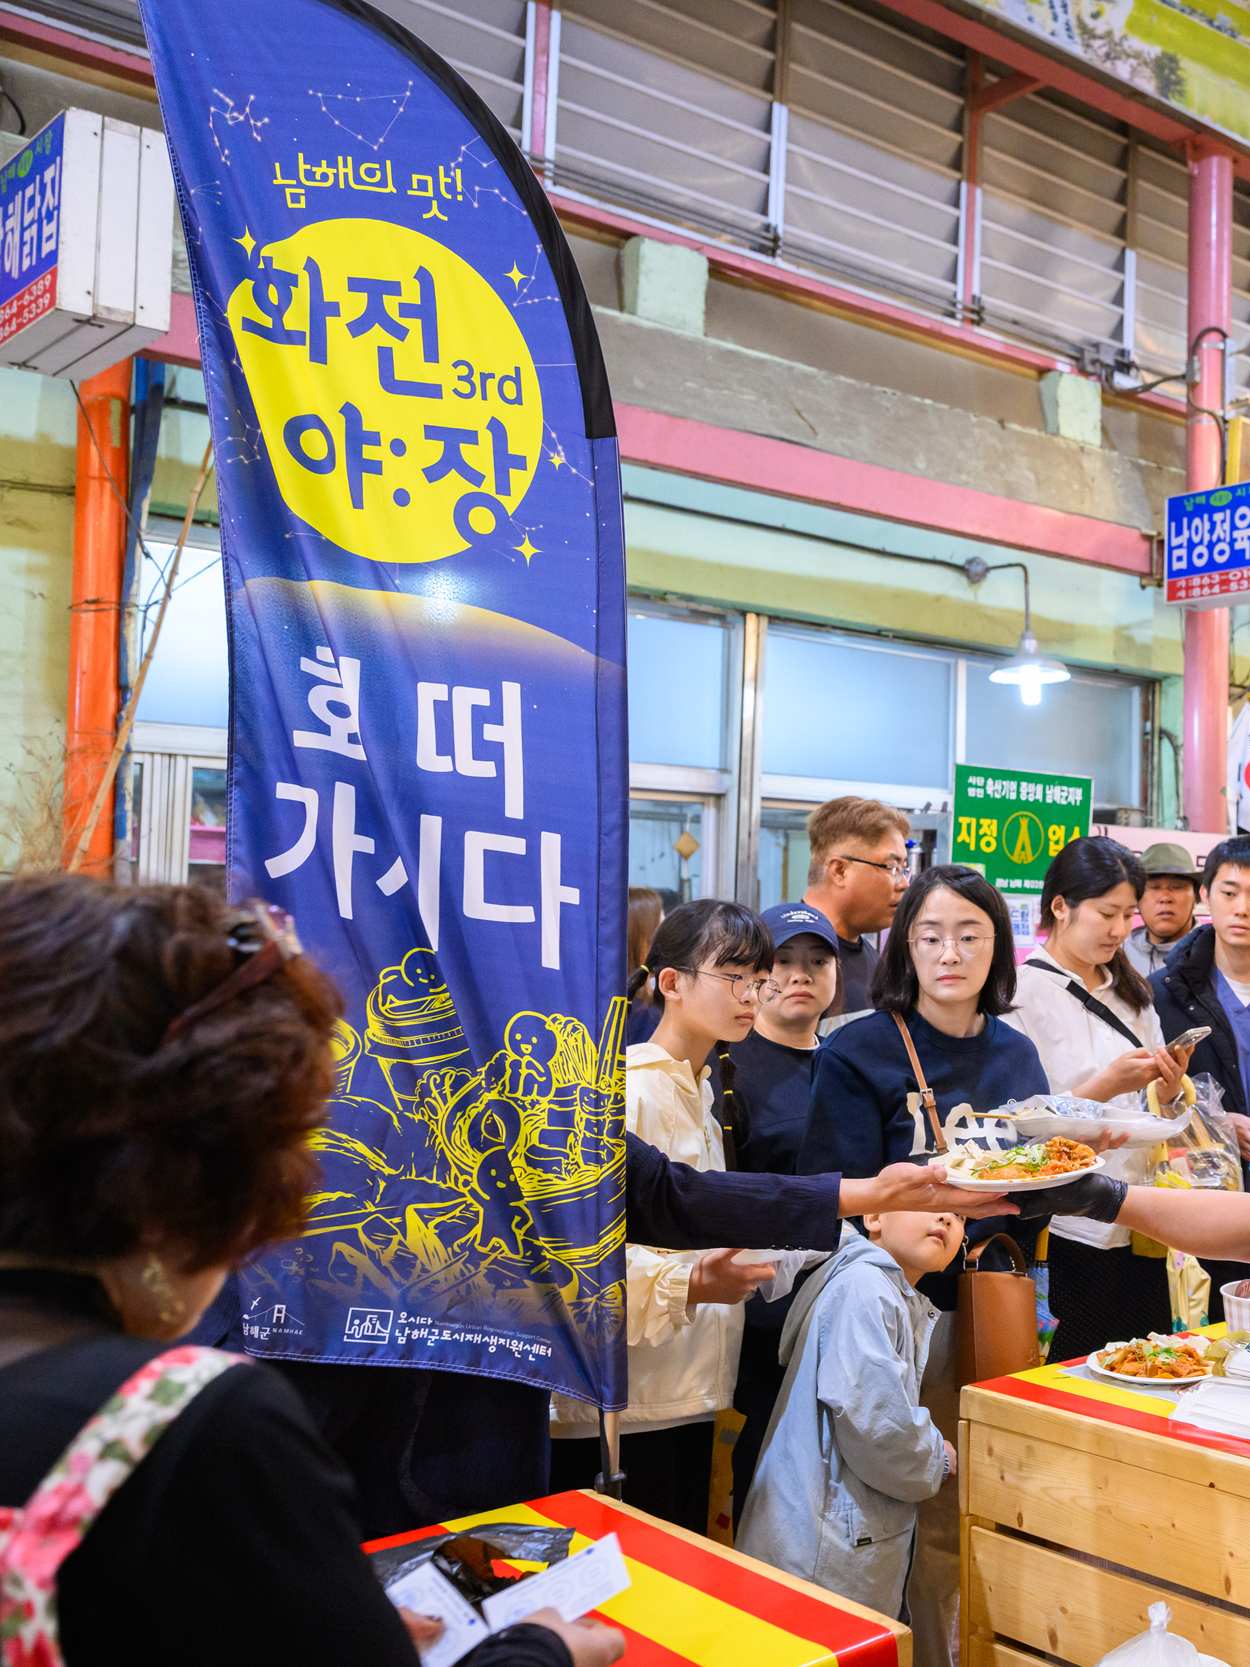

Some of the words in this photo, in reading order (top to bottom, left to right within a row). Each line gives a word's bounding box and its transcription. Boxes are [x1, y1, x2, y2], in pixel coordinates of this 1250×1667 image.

[0, 156, 60, 279] 해닭집
[272, 152, 397, 209] 남해의
[407, 168, 464, 222] 맛!
[242, 255, 443, 400] 화전
[451, 359, 524, 407] 3rd
[957, 816, 998, 853] 지정
[264, 781, 581, 970] 가시다
[395, 1327, 552, 1361] 남해군도시재생지원센터
[398, 1311, 433, 1325] 오시다
